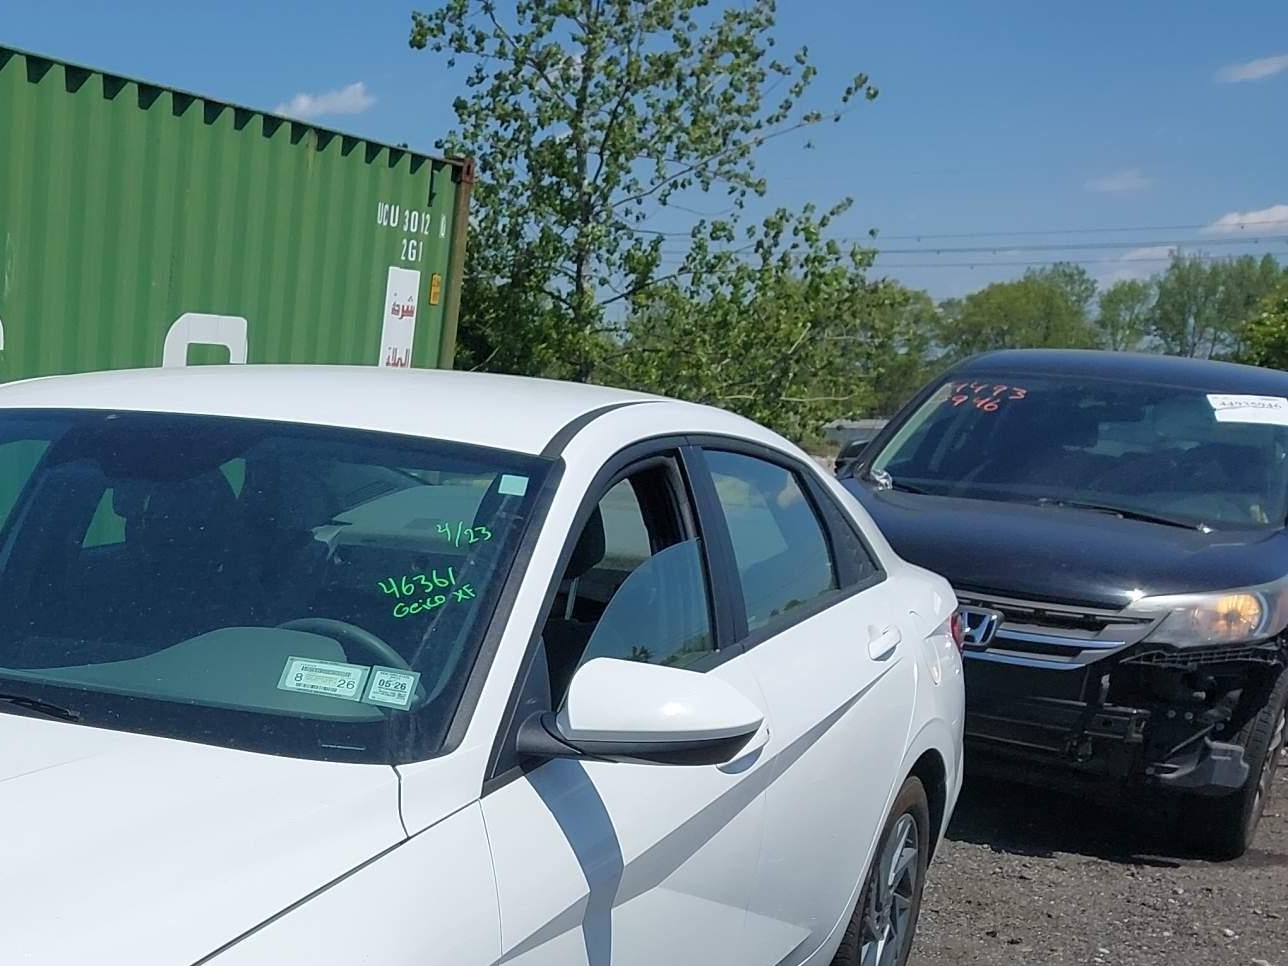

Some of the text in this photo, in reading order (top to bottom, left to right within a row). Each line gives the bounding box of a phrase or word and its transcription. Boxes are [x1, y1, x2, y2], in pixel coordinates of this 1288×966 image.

[377, 567, 457, 598] 46361
[294, 672, 303, 682] 8
[336, 679, 356, 690] 26
